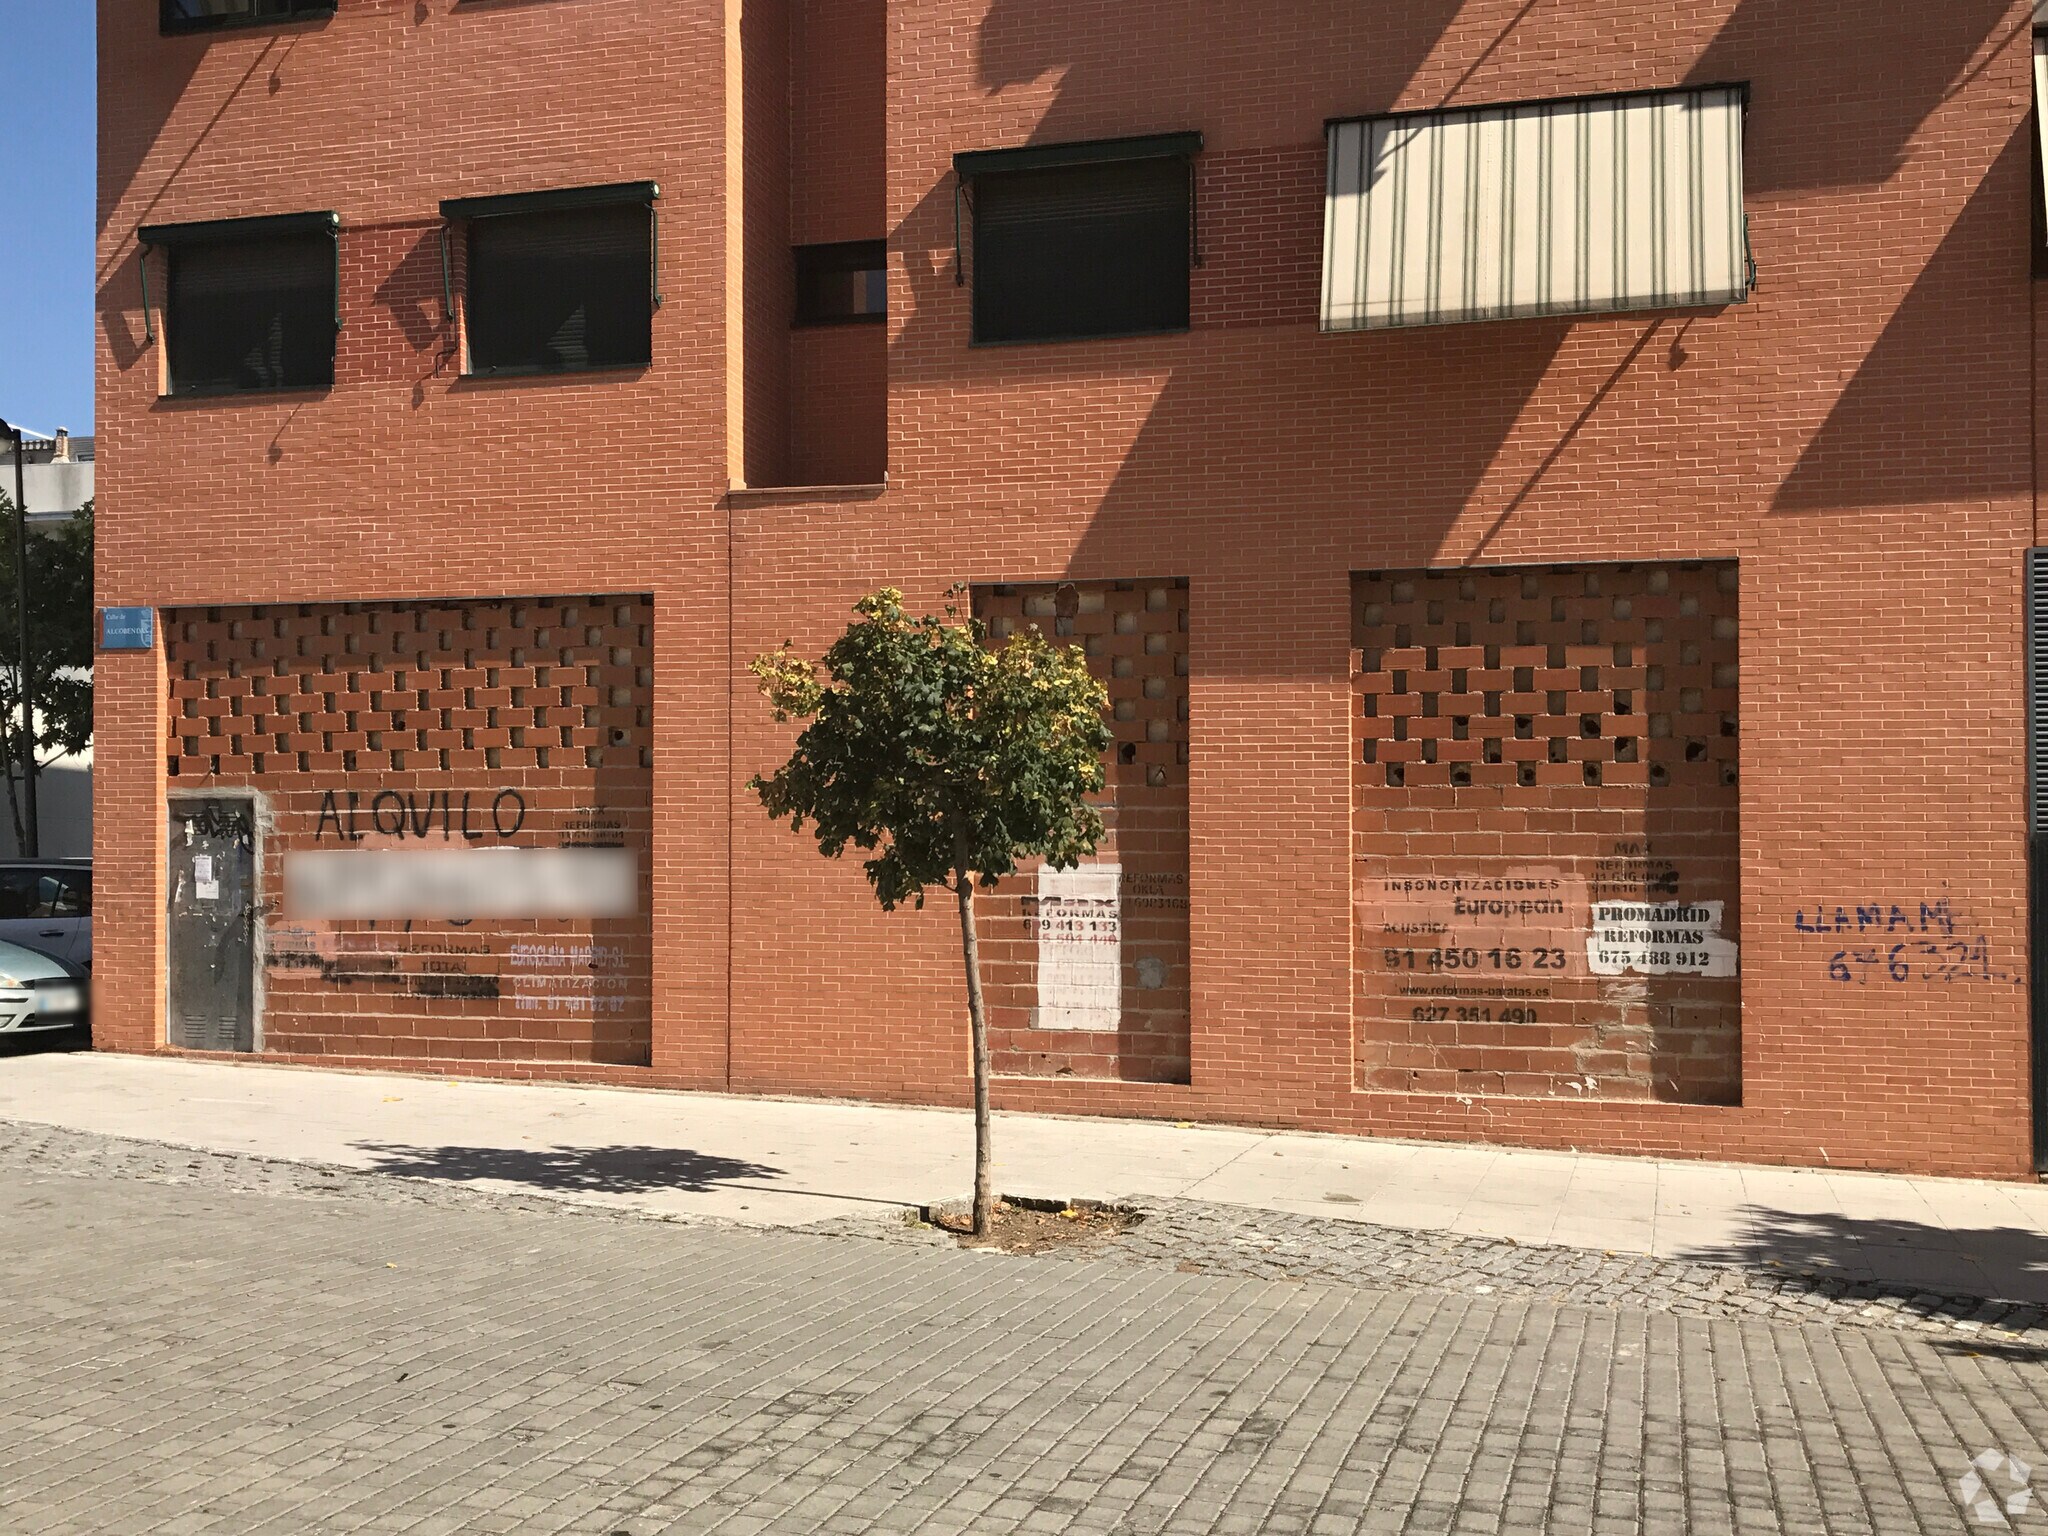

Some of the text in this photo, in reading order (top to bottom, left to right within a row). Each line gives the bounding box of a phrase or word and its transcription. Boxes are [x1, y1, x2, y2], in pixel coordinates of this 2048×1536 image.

[1384, 880, 1559, 891] INSONORIZACIONES
[1454, 896, 1563, 918] European
[1598, 907, 1710, 922] PROMADRID
[1604, 930, 1704, 944] REFORMAS
[1427, 948, 1479, 969] 450
[1488, 948, 1522, 969] 16
[1533, 948, 1567, 969] 23
[1600, 951, 1710, 967] 675 488 912
[1412, 1007, 1537, 1024] 627 351 490
